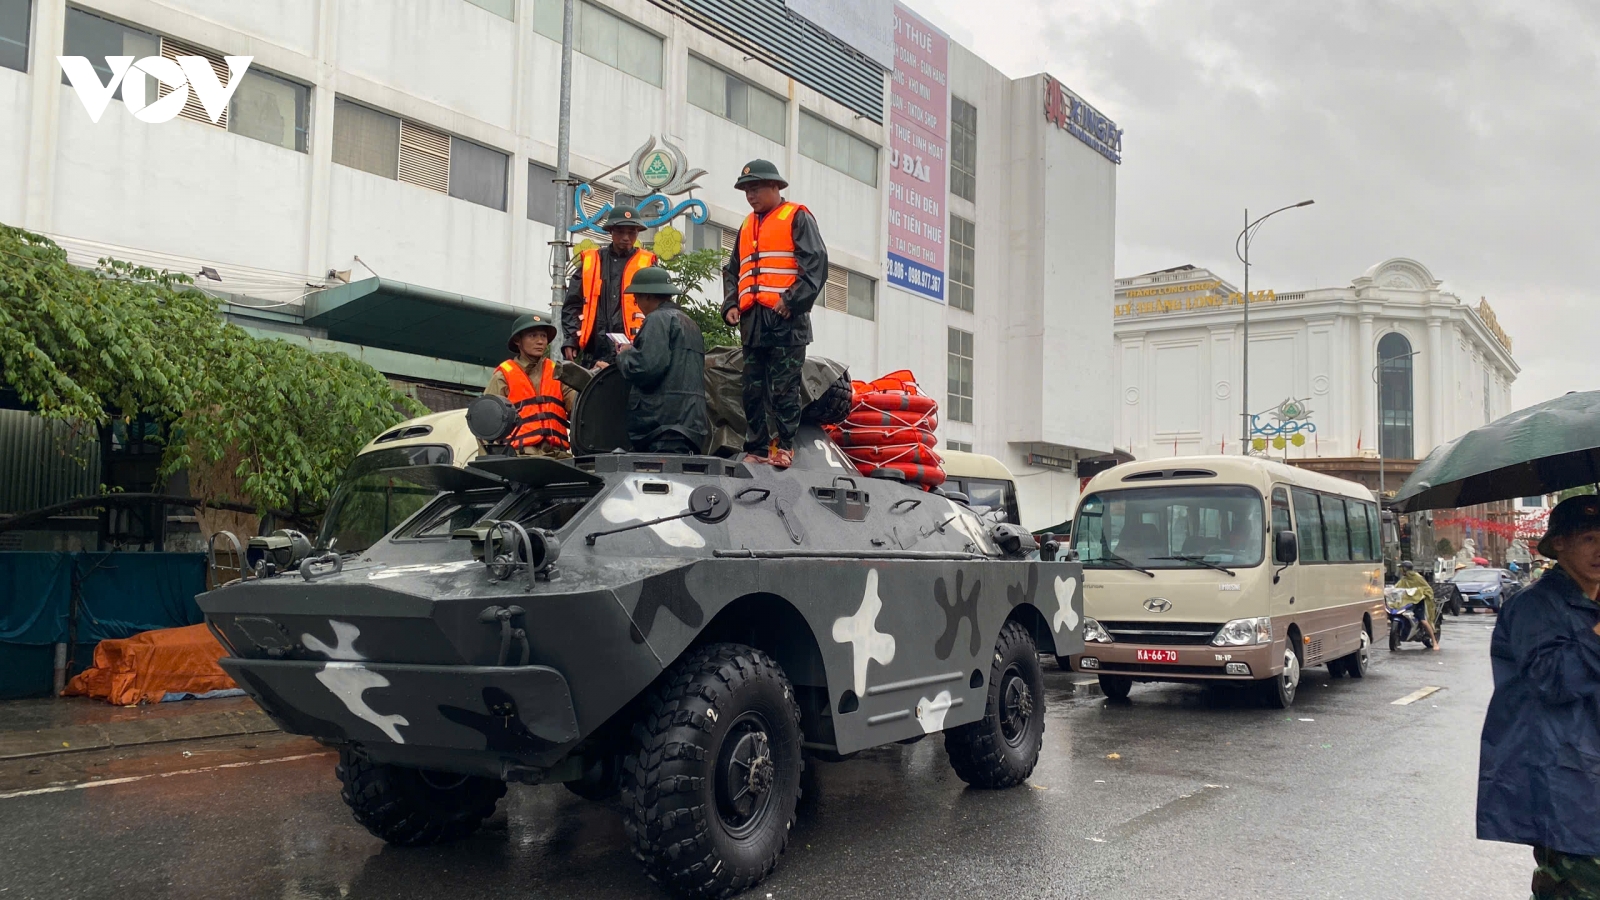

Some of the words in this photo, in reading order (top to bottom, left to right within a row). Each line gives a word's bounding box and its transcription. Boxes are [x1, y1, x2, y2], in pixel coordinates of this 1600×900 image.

[905, 22, 932, 54] THUÊ
[912, 132, 927, 152] LINH
[906, 187, 921, 210] LÊN
[923, 195, 939, 217] ĐẾN
[923, 221, 942, 244] THUÊ
[1158, 285, 1185, 296] LONG
[1186, 294, 1223, 311] LONG
[1137, 649, 1177, 661] KA-66-70
